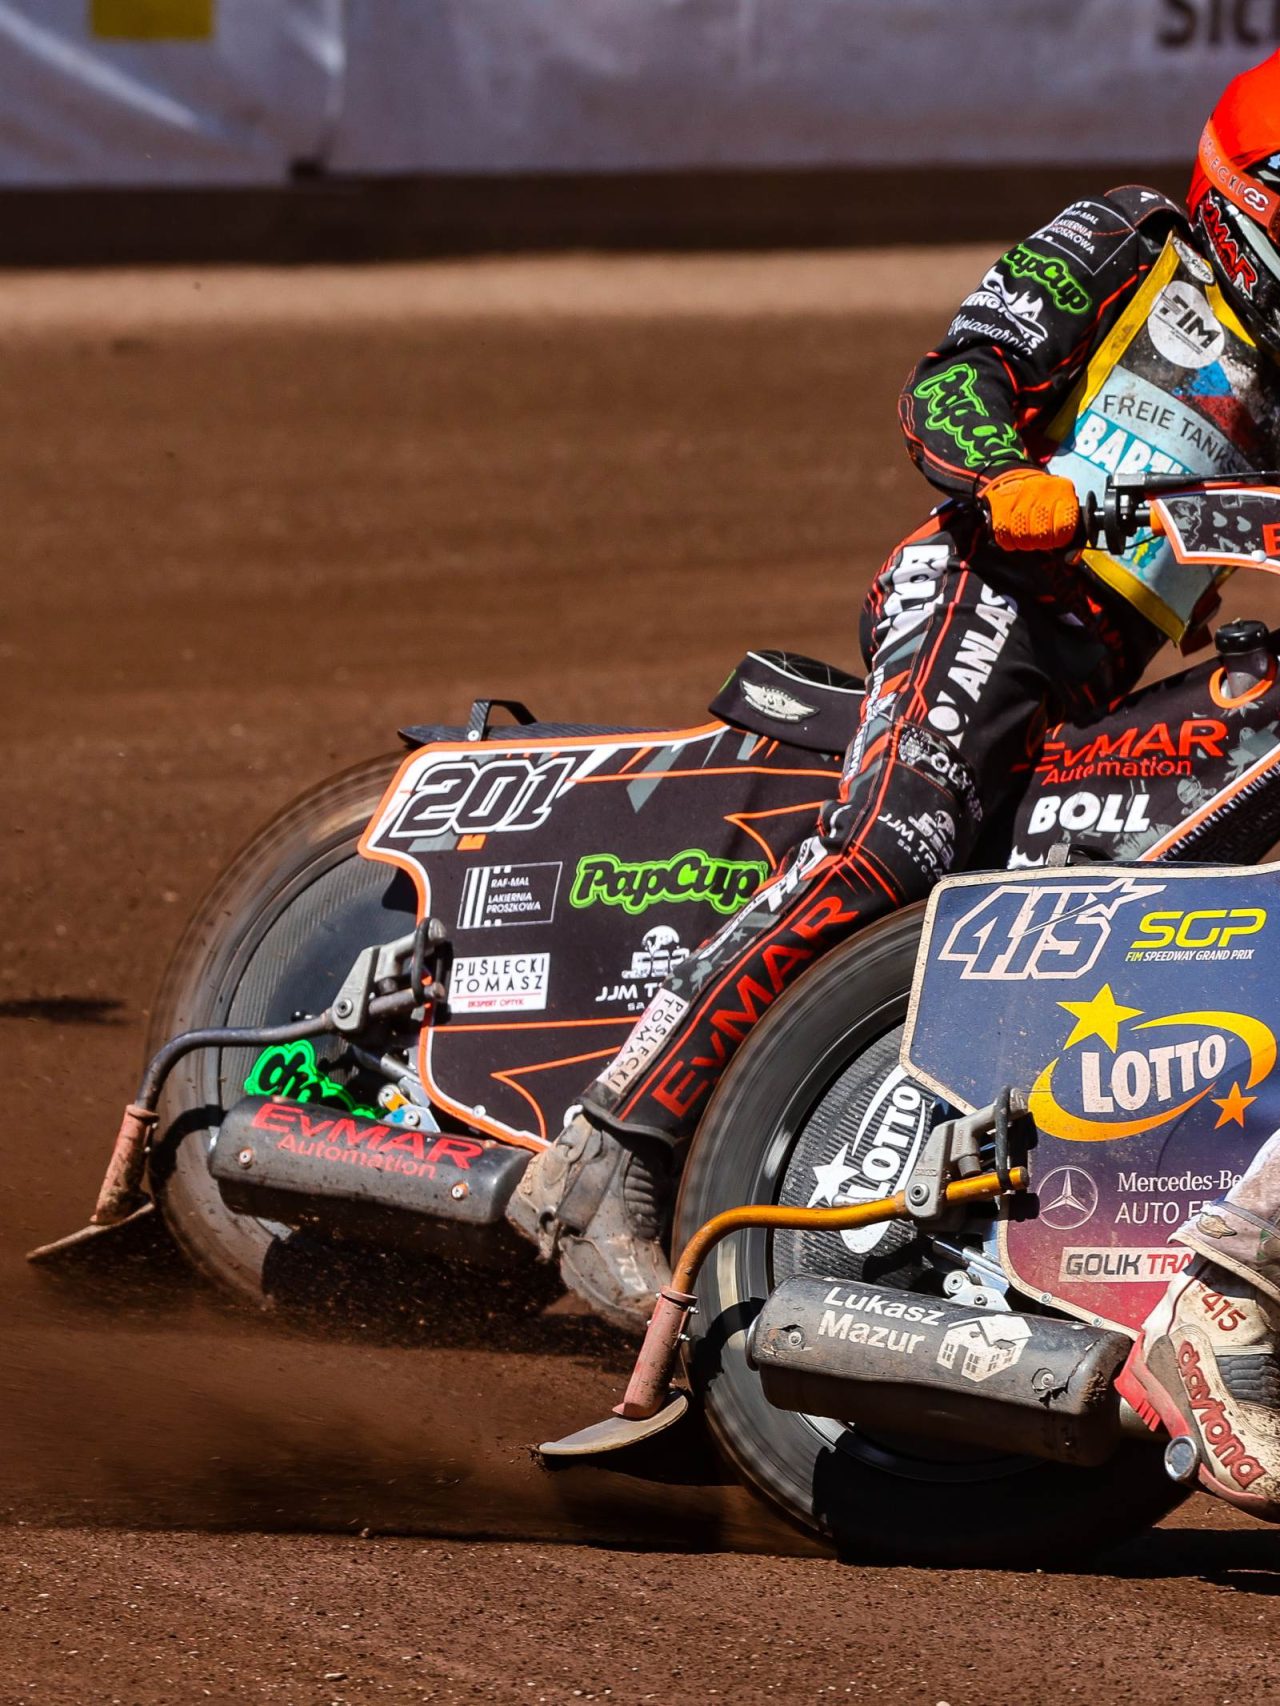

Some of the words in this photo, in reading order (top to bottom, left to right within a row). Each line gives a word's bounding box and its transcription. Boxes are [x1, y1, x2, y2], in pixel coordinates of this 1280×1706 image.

[1103, 394, 1176, 430] FREIE
[1042, 757, 1193, 787] Automation
[388, 756, 575, 839] 201
[1027, 791, 1152, 835] BOLL
[488, 892, 533, 905] LAKIERNIA
[491, 876, 530, 889] RAF-MAL
[571, 854, 766, 911] PapCup
[486, 901, 542, 914] PROSZKOWA
[938, 878, 1166, 980] 415
[1130, 908, 1267, 948] SGP
[455, 957, 546, 978] PUŚLECKI
[1125, 951, 1143, 962] FIM
[1143, 950, 1195, 961] SPEEDWAY
[1196, 950, 1231, 960] GRAND
[1231, 949, 1255, 960] PRIX
[454, 975, 543, 994] TOMASZ
[595, 983, 639, 1002] JJM
[1080, 1033, 1228, 1114] LOTTO
[251, 1102, 484, 1170] EvMAR
[277, 1133, 437, 1181] Automation
[1116, 1169, 1243, 1193] Mercedes-Be
[1114, 1202, 1180, 1225] AUTO
[1066, 1254, 1142, 1276] GOLIK
[822, 1286, 946, 1328] Lukasz
[1202, 1291, 1247, 1332] 415
[818, 1311, 929, 1356] Mazur
[1177, 1340, 1268, 1490] daytona
